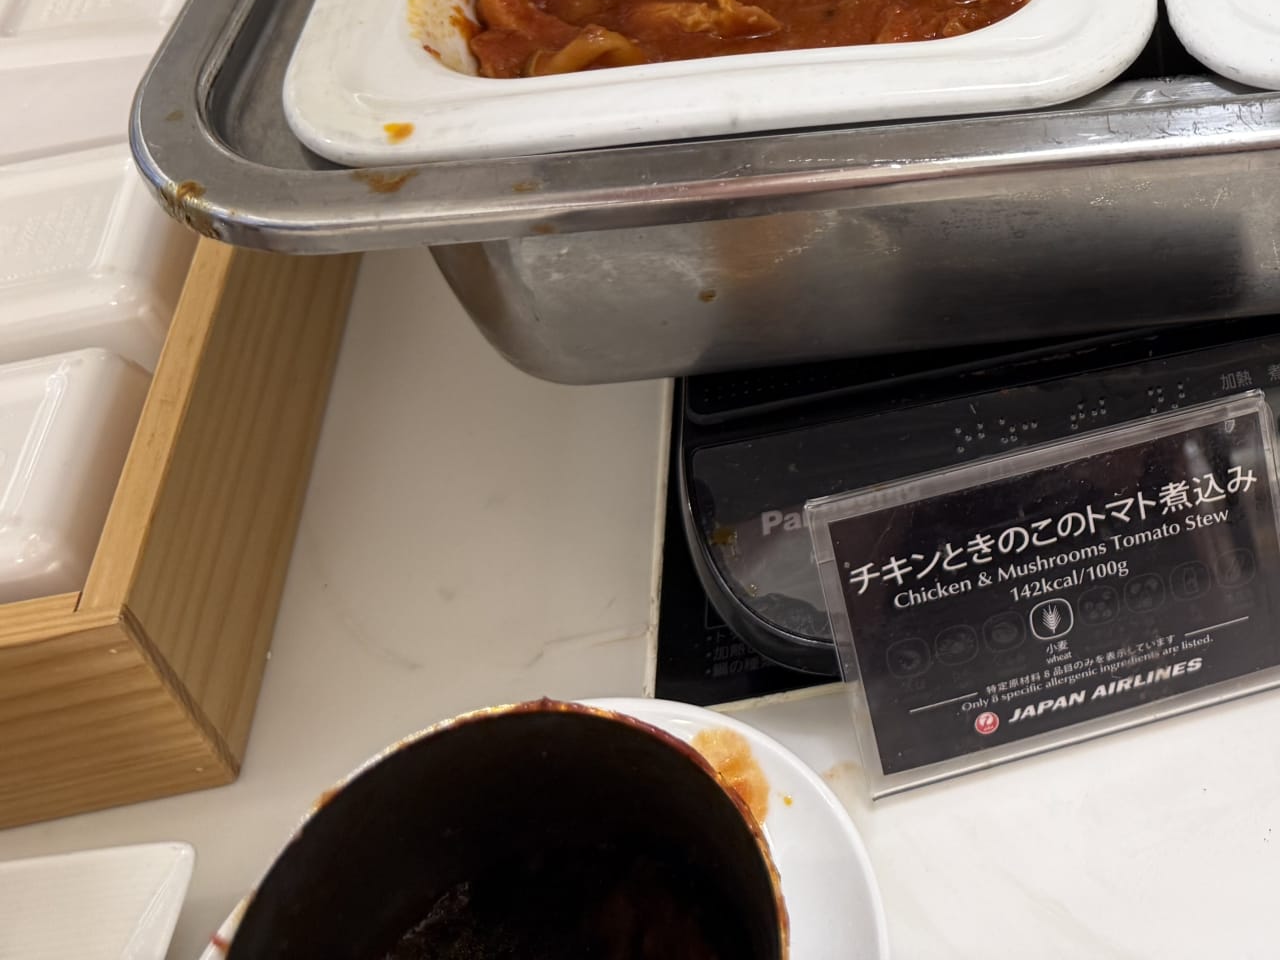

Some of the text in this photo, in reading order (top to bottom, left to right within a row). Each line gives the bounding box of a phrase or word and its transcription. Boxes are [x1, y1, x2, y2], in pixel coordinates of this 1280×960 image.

[1220, 370, 1252, 390] 加熱
[849, 465, 1258, 595] チキンときのこのトマト煮込み
[893, 509, 1230, 608] Chicken & Mushrooms Tomato Stew
[1009, 559, 1130, 602] 142kcal/100g
[961, 633, 1214, 713] Only 8 specific allergenic ingredients are listed.
[1045, 650, 1073, 665] wheat
[1046, 639, 1069, 655] 小麦
[1008, 656, 1204, 724] JAPAN AIRLINES
